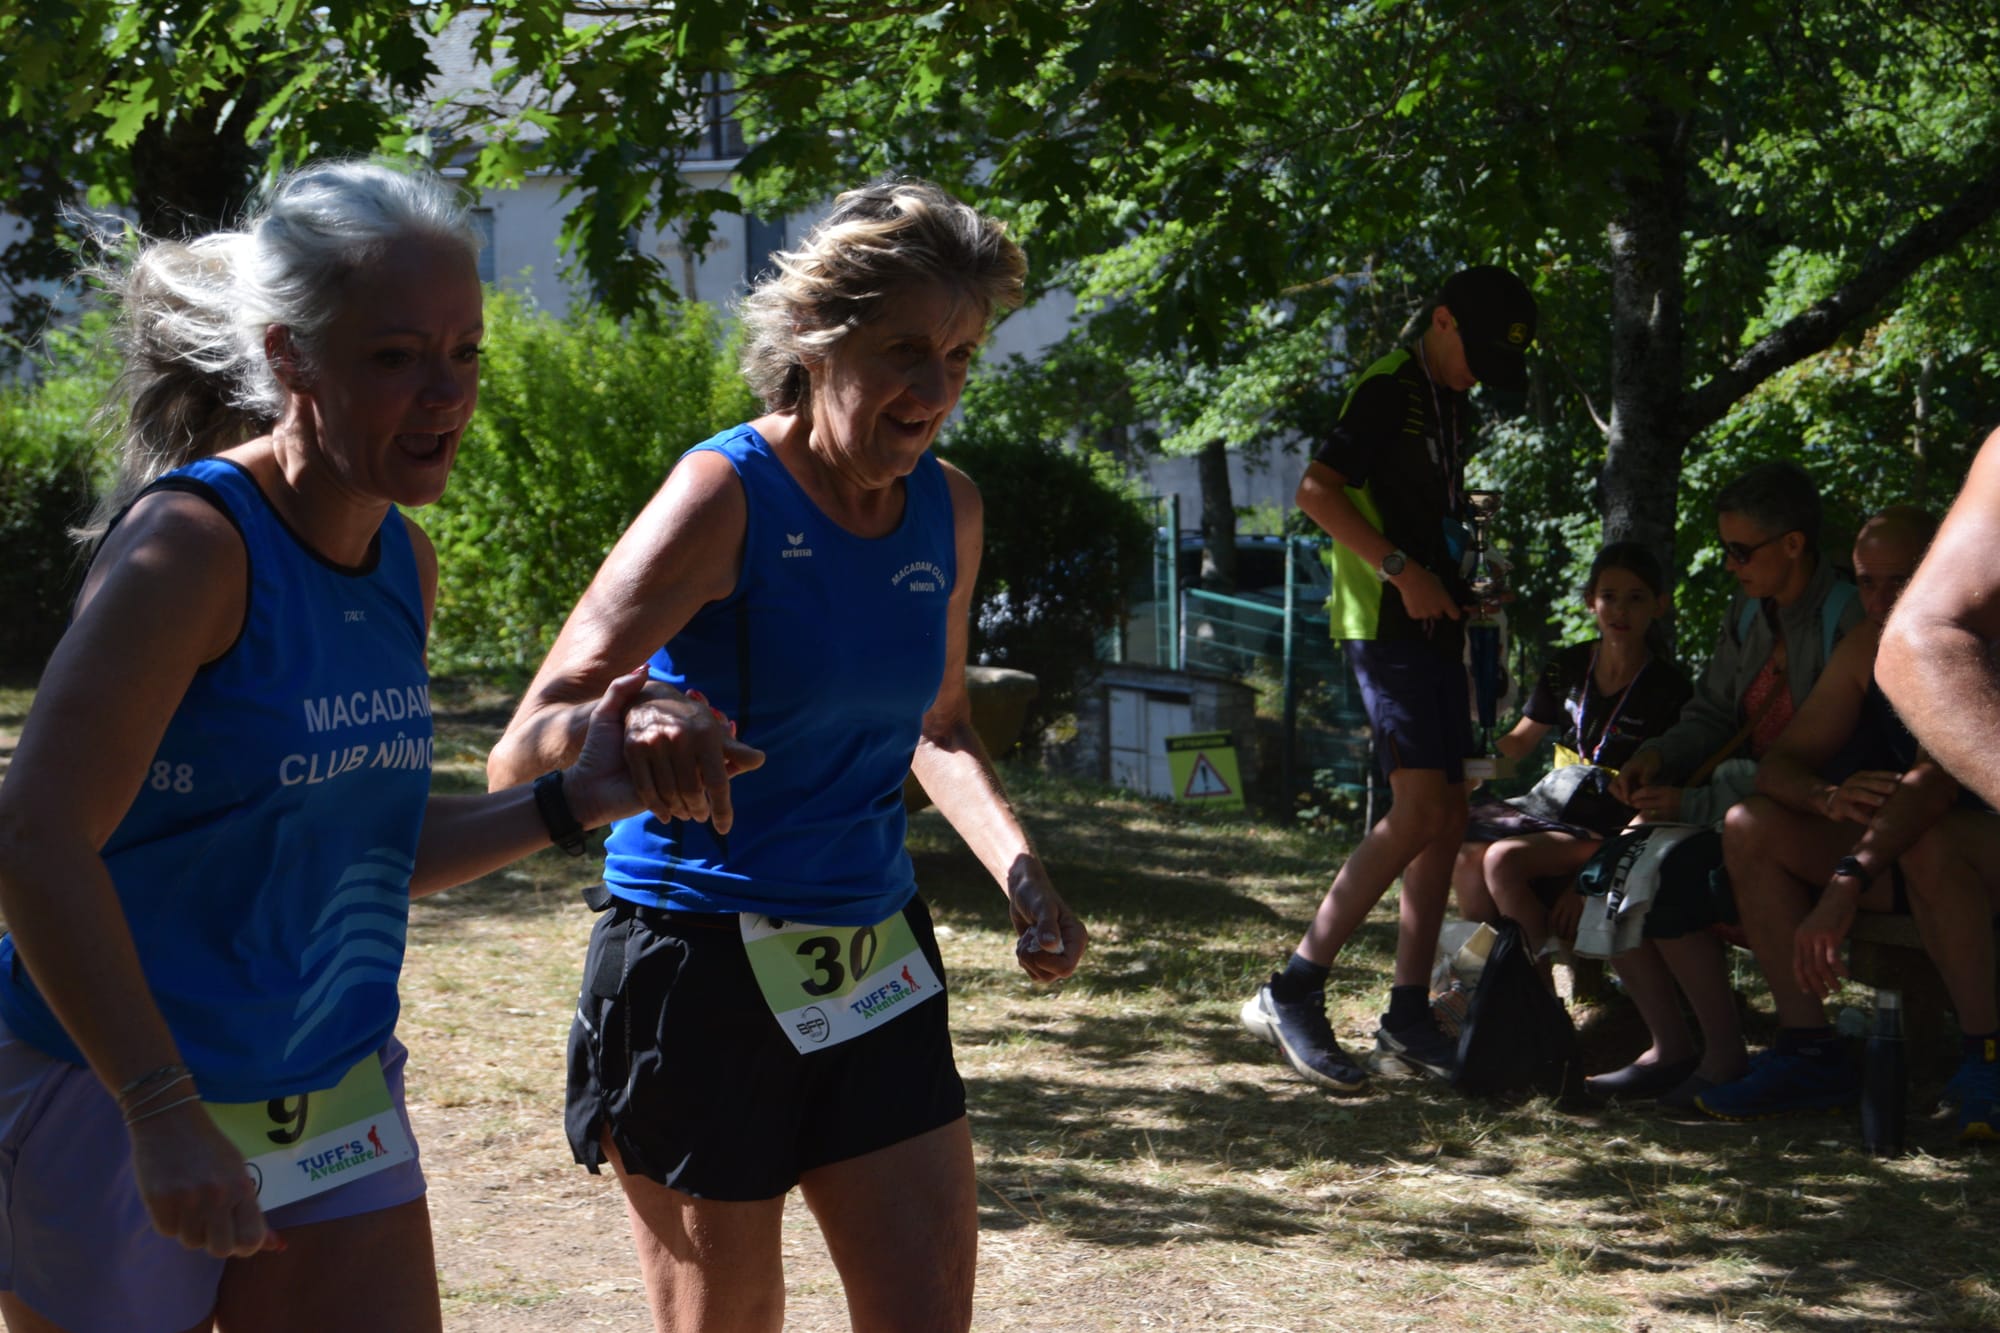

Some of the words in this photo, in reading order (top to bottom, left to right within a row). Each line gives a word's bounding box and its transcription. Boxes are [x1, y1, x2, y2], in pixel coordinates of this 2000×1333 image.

[781, 547, 812, 558] erima
[891, 561, 932, 587] MACADAM
[151, 760, 194, 794] 88
[279, 745, 369, 787] CLUB
[796, 926, 877, 997] 30
[851, 980, 901, 1014] TUFF'S
[862, 986, 911, 1020] Aventure
[267, 1094, 308, 1144] 9
[297, 1140, 364, 1174] TUFF'S
[310, 1149, 374, 1182] Aventure
